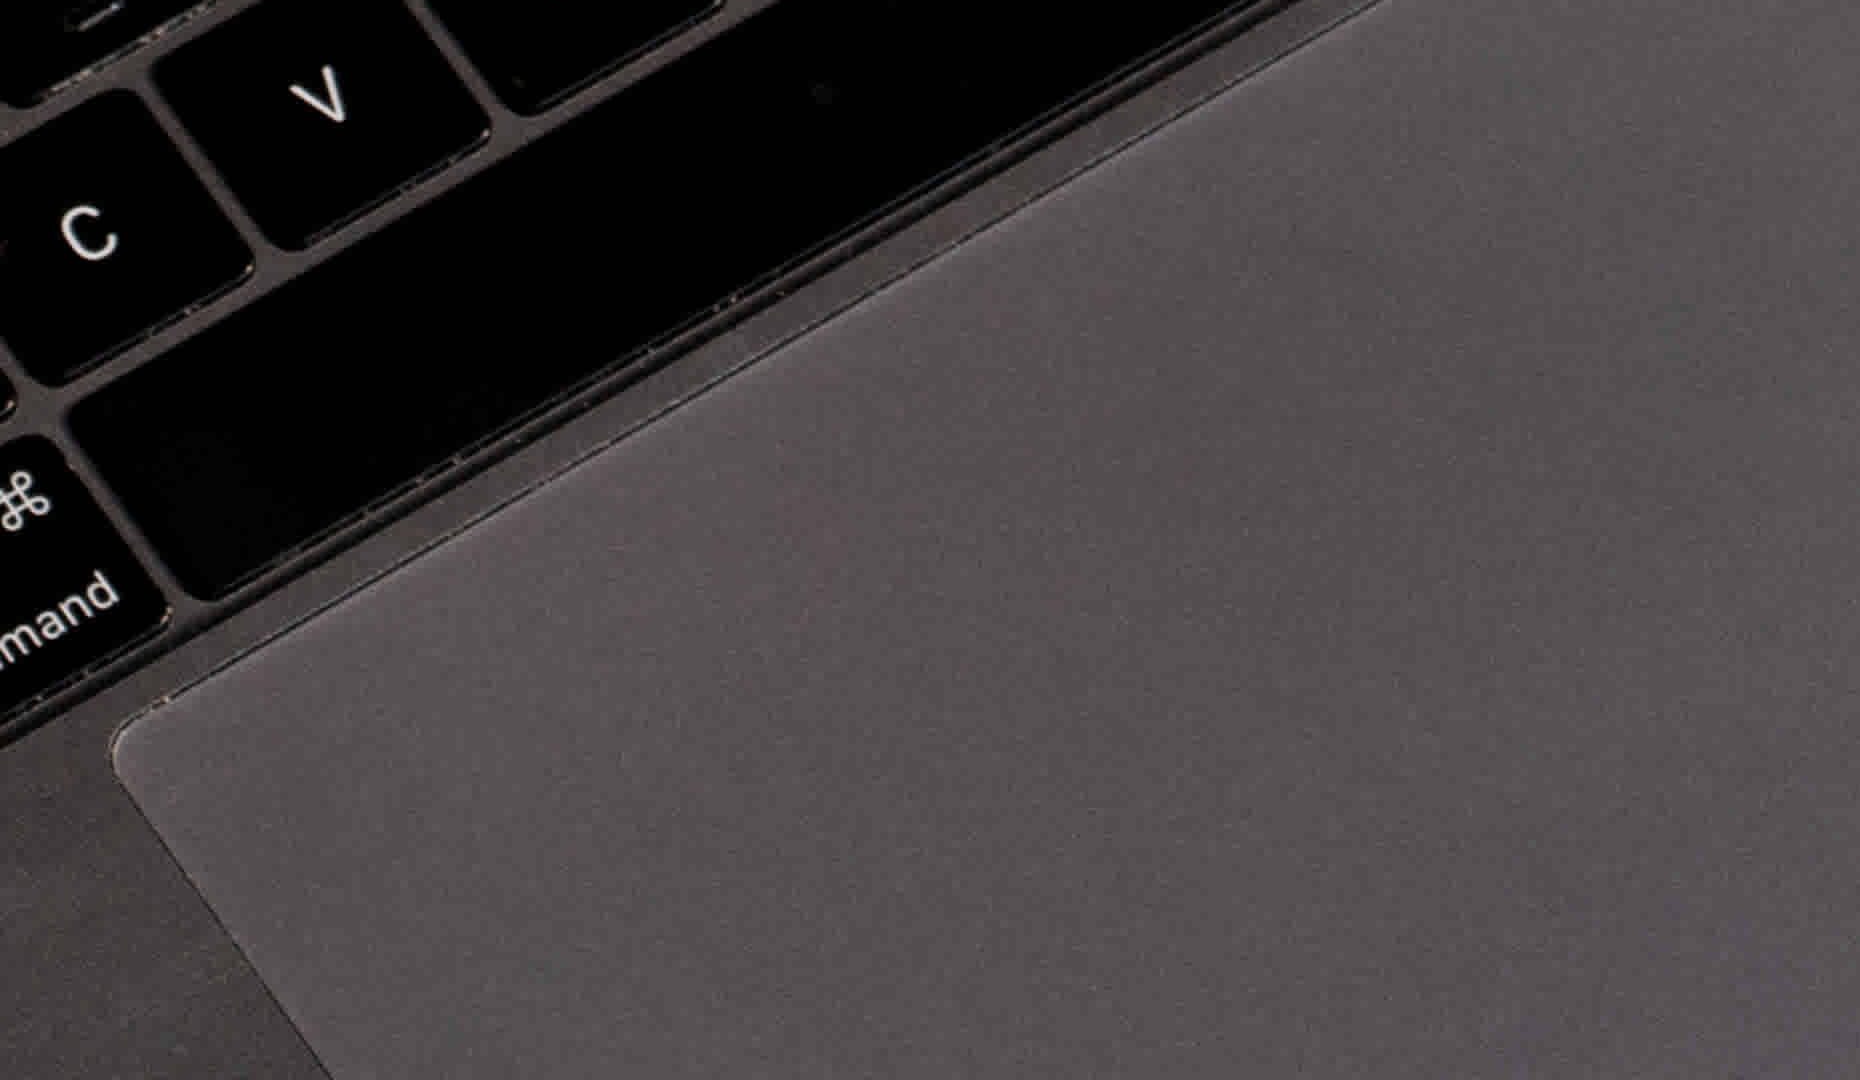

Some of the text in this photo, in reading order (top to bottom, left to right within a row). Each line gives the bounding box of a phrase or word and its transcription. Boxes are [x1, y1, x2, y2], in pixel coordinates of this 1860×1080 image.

[288, 65, 346, 123] V
[60, 204, 118, 261] C
[0, 569, 120, 670] mand
